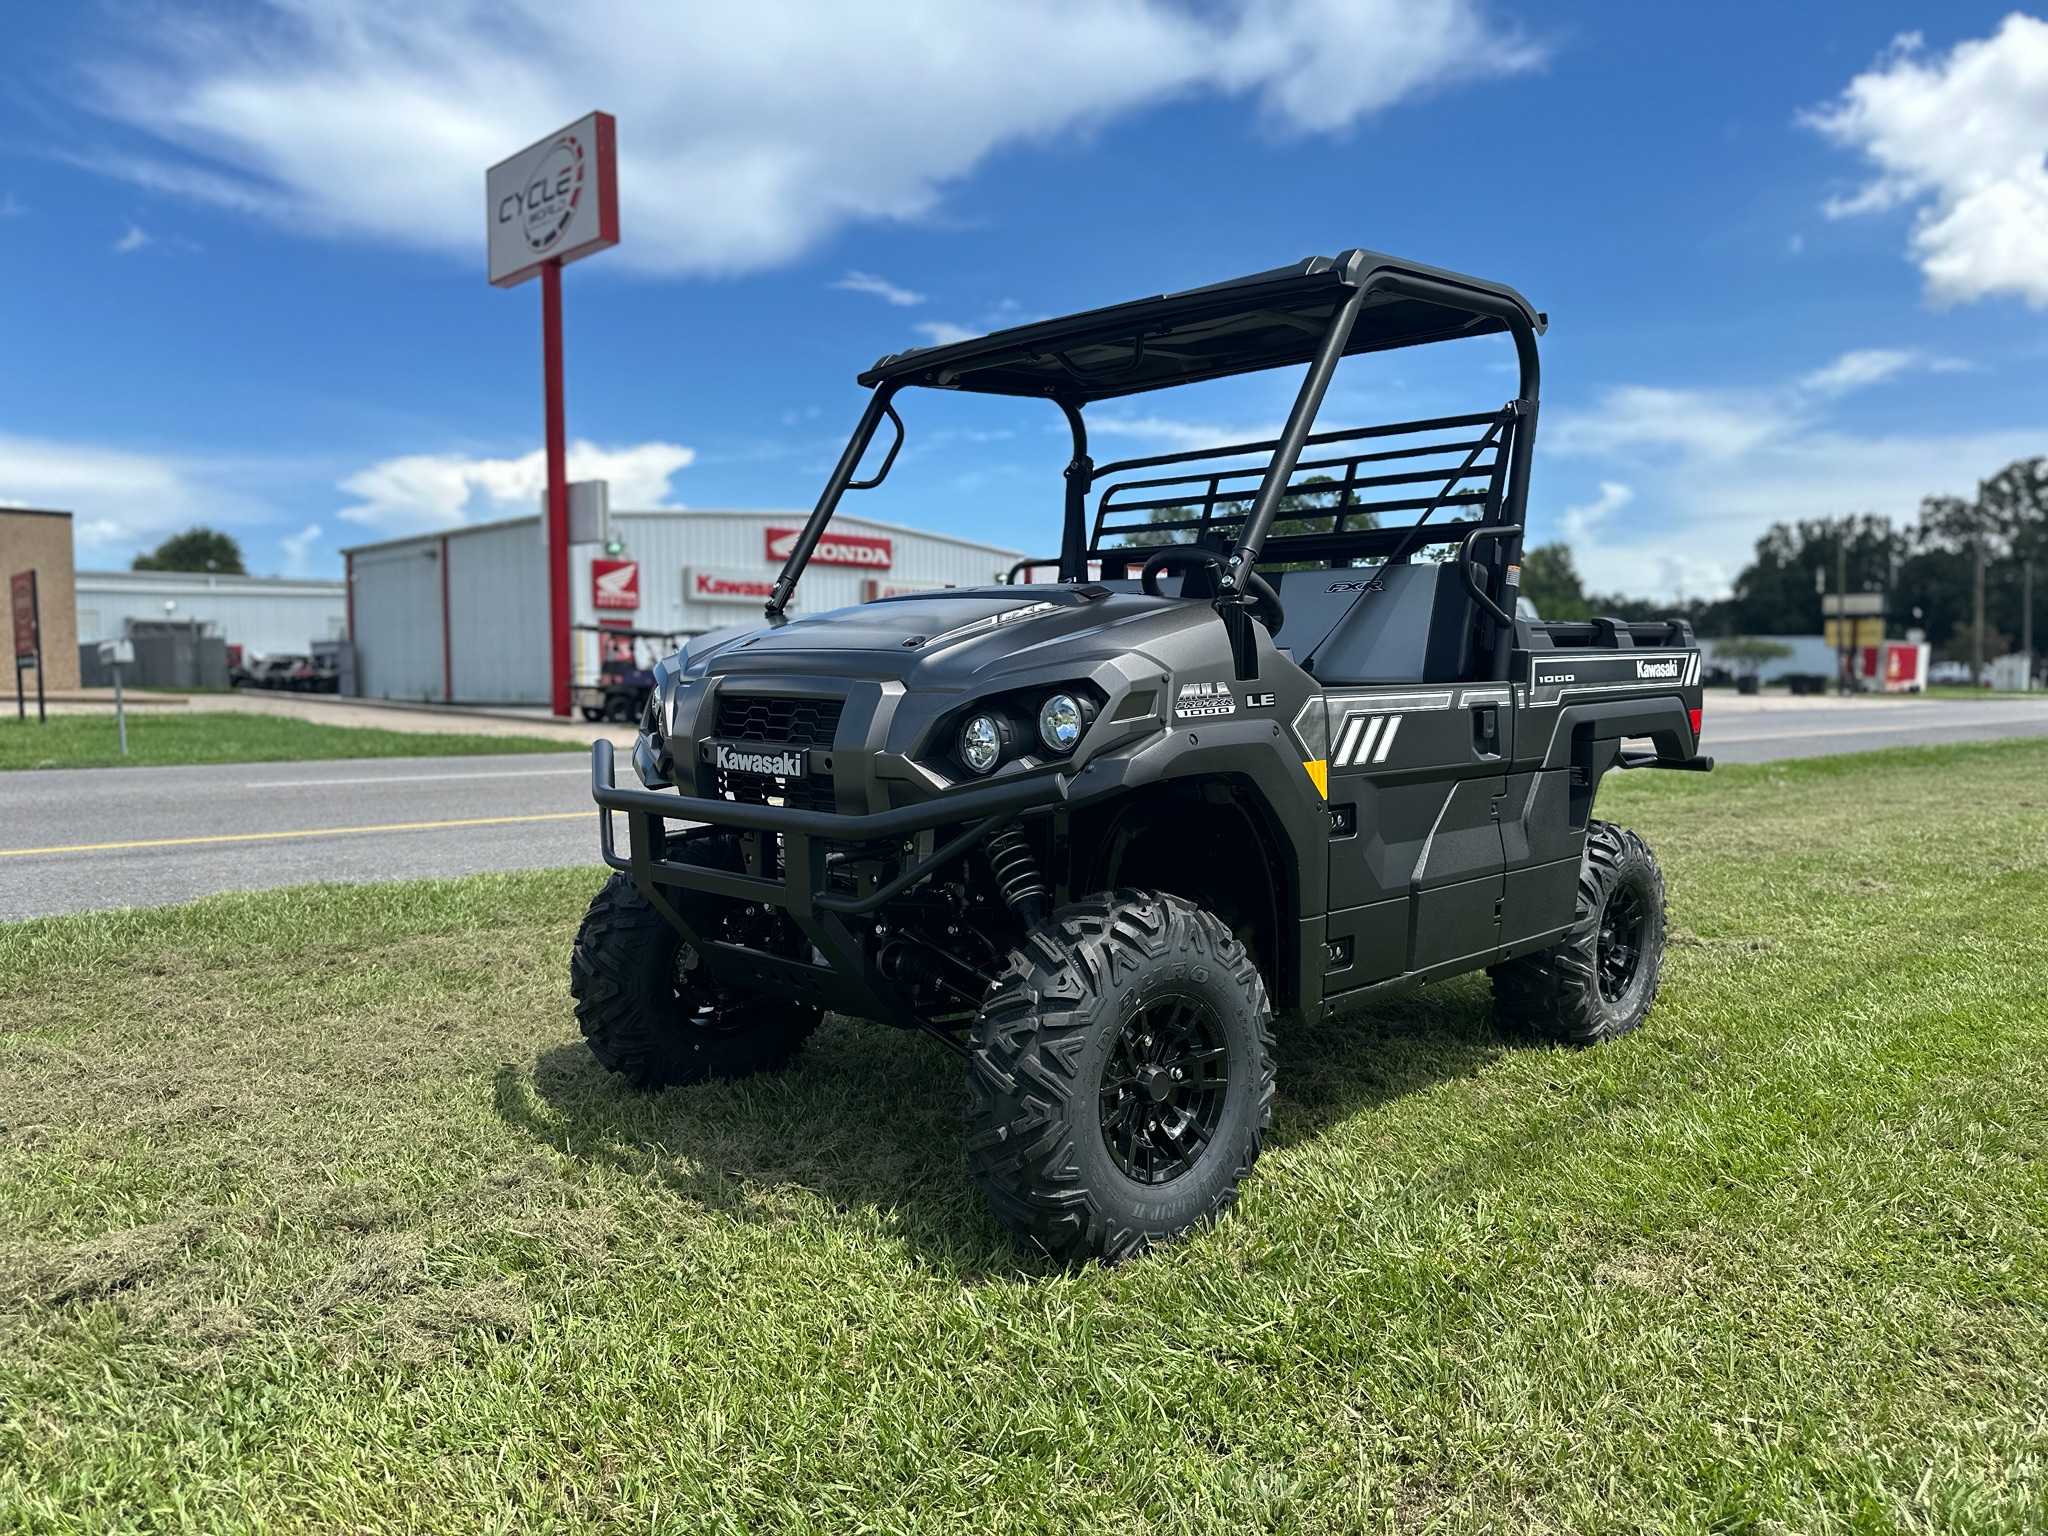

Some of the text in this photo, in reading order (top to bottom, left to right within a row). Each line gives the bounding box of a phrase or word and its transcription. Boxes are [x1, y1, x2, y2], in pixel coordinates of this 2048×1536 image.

[499, 166, 571, 223] CYCLE
[1324, 580, 1386, 593] FXR
[1636, 660, 1678, 678] Kawasaki
[1539, 674, 1575, 683] 1000
[1178, 682, 1233, 701] MULE
[1246, 693, 1275, 707] LE
[1183, 707, 1230, 717] 1000
[717, 746, 801, 777] Kawasaki
[1119, 962, 1211, 1018] DURO
